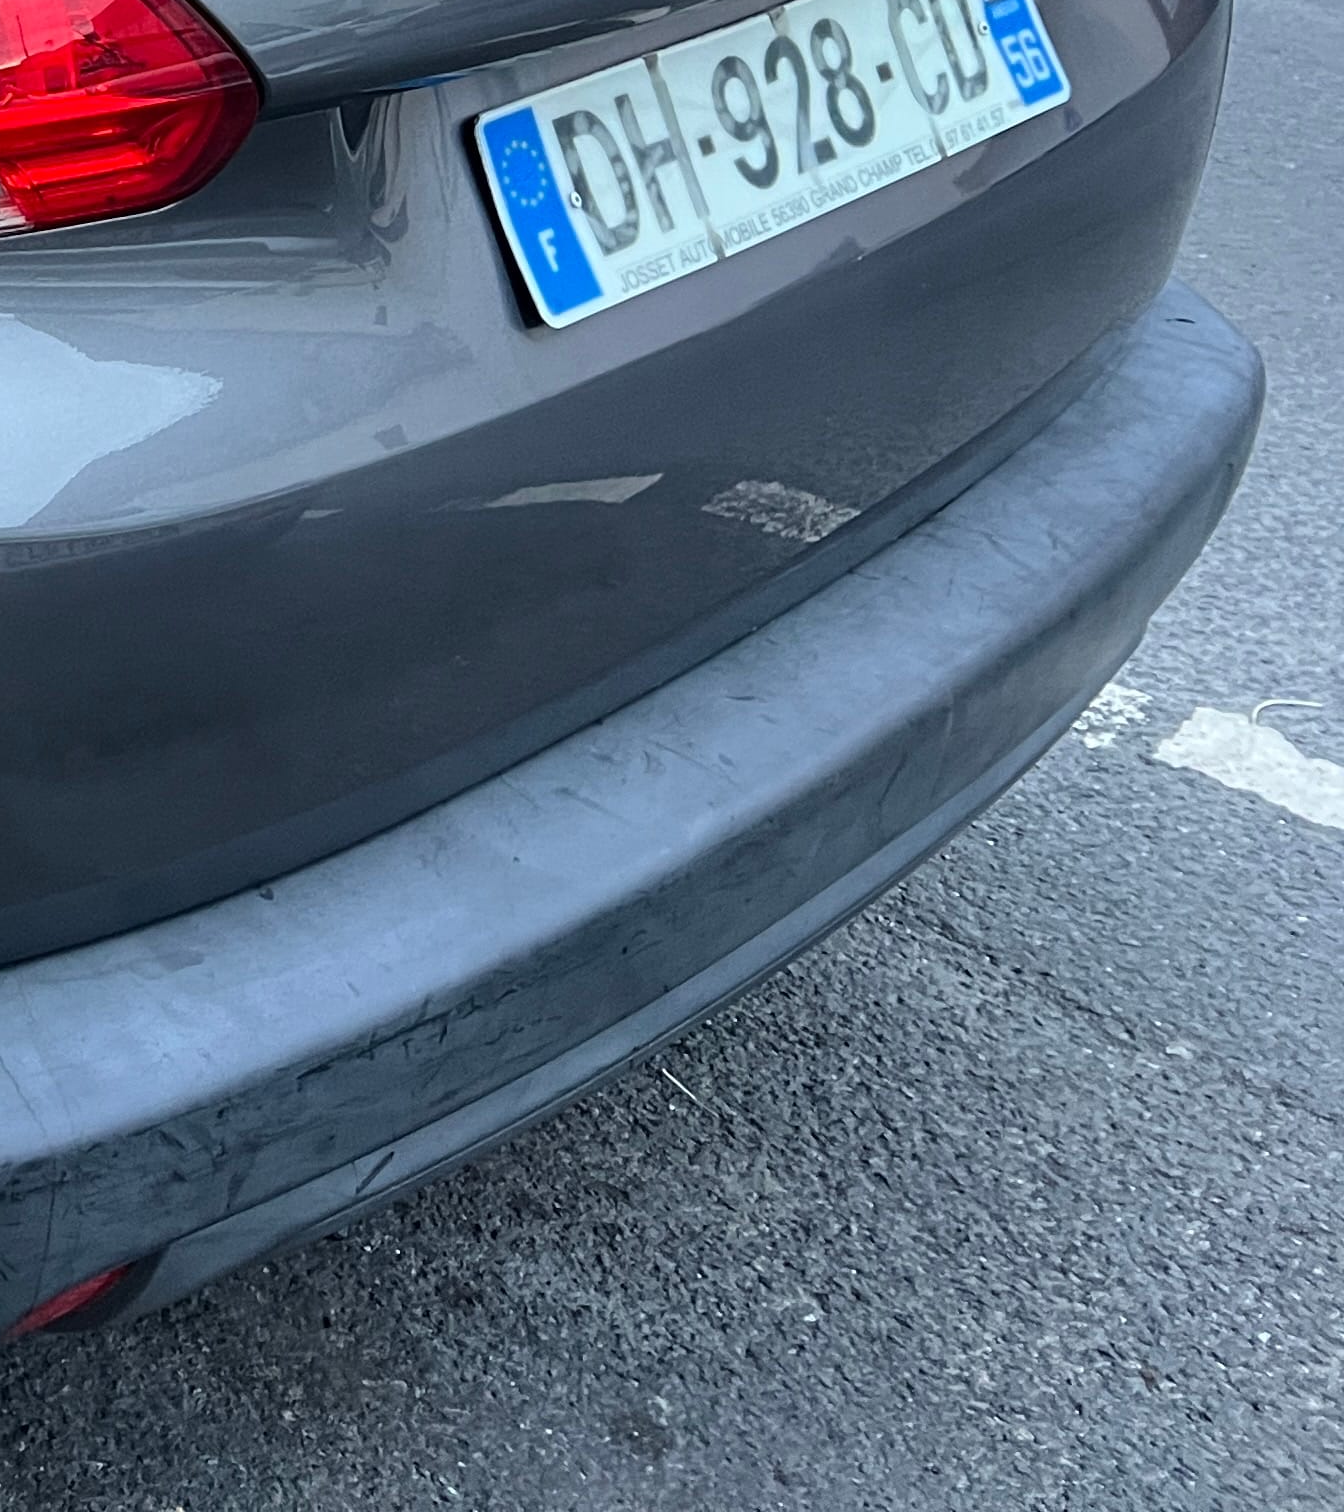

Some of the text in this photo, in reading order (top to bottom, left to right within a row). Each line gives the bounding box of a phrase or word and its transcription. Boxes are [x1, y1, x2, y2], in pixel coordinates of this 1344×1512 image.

[1001, 28, 1051, 88] 56
[537, 227, 560, 272] F
[620, 253, 676, 293] JOSSET
[812, 176, 858, 209] GRAND
[858, 157, 902, 186] CHAMP
